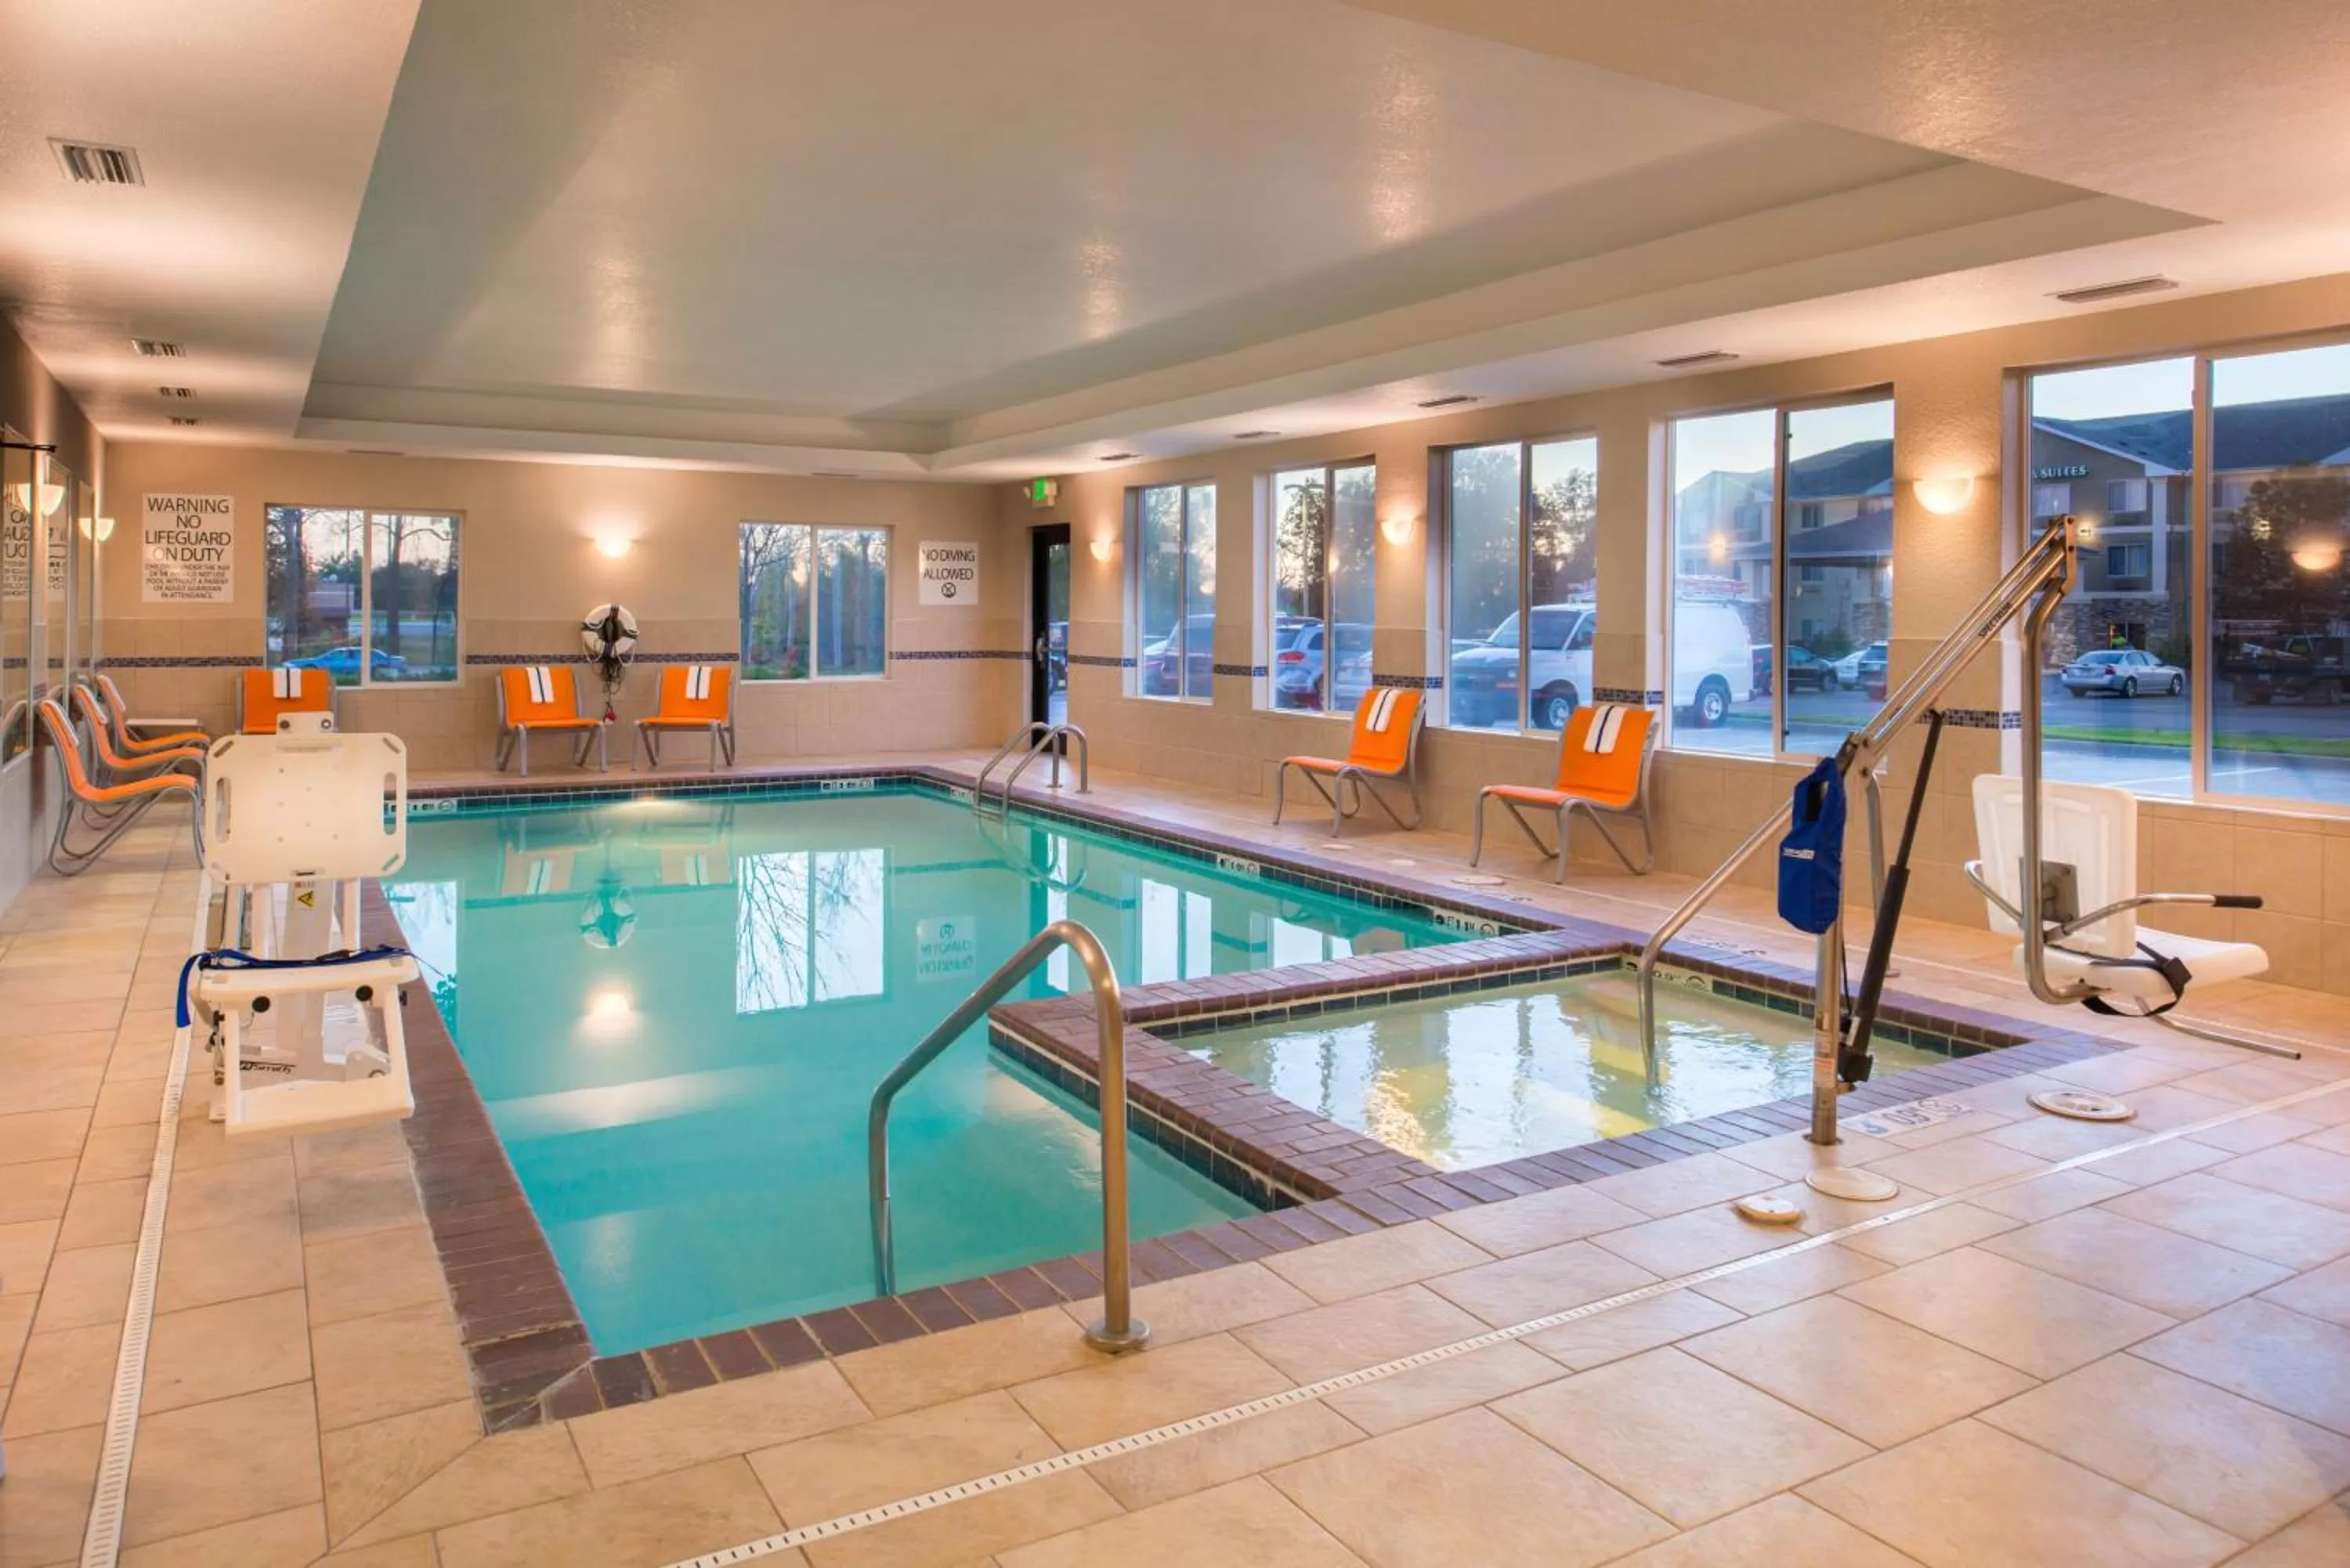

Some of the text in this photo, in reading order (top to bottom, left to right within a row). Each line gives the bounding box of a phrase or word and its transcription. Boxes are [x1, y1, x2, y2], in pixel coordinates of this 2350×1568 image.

[2041, 464, 2087, 479] SUITES
[147, 497, 230, 514] WARNING
[176, 515, 201, 529] NO
[145, 530, 231, 546] LIFEGUARD
[153, 547, 225, 562] ON DUTY
[923, 549, 975, 562] NO DIVING
[923, 568, 974, 580] ALLOWED
